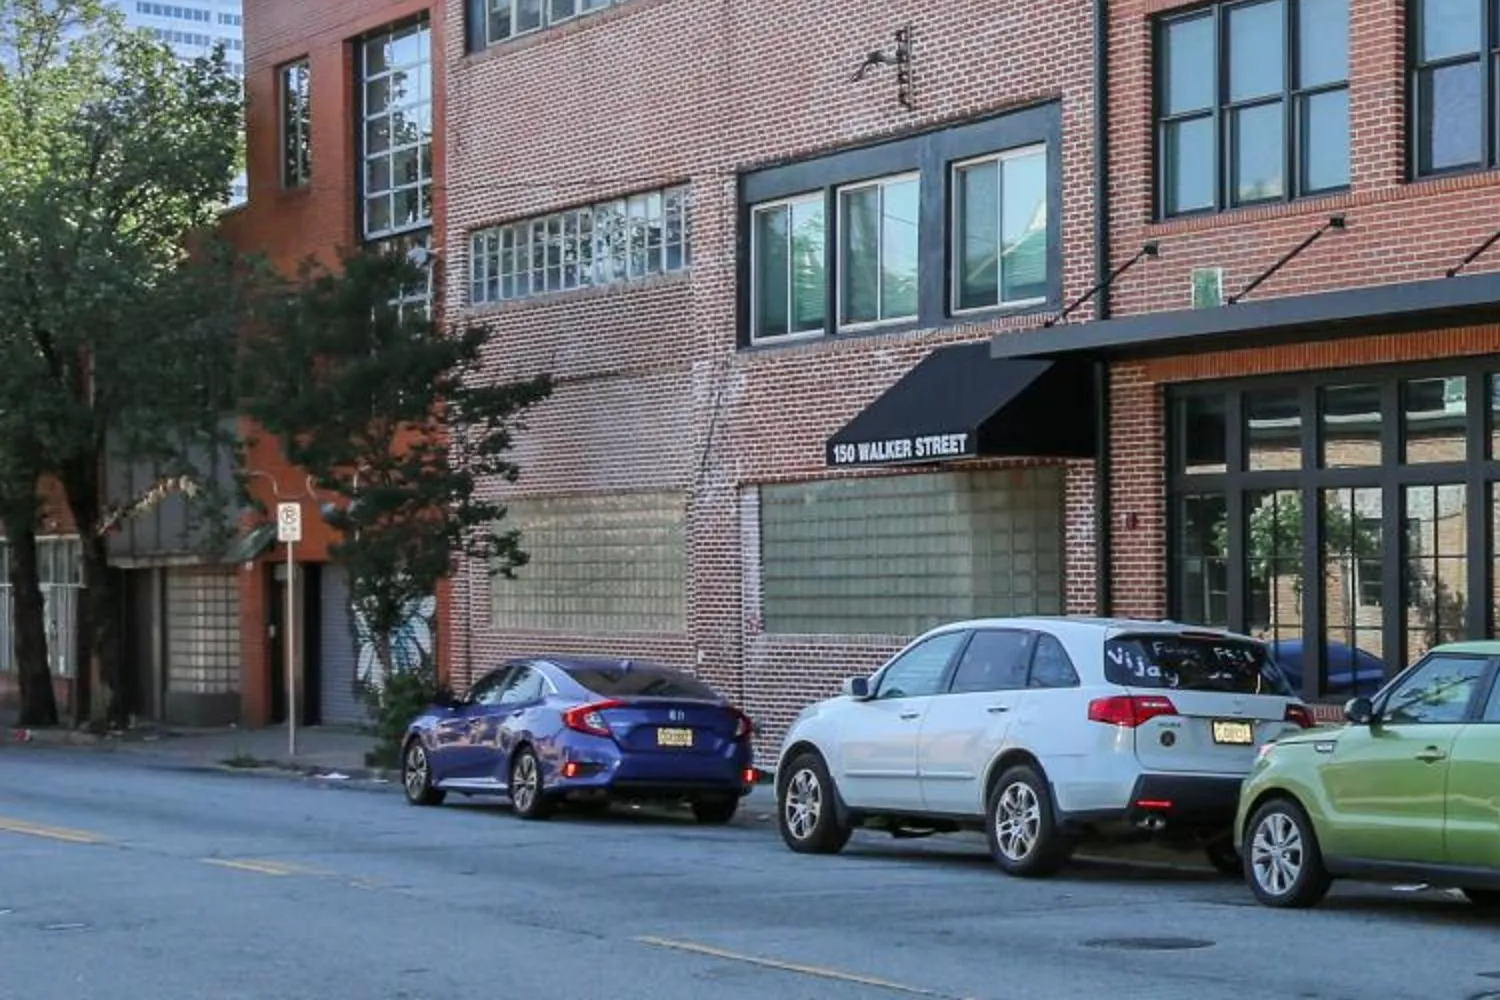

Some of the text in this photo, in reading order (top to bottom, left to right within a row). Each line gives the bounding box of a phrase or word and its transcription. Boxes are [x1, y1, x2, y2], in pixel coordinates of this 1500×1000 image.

[832, 432, 968, 464] 150 WALKER STREET
[1107, 647, 1180, 688] Vijay
